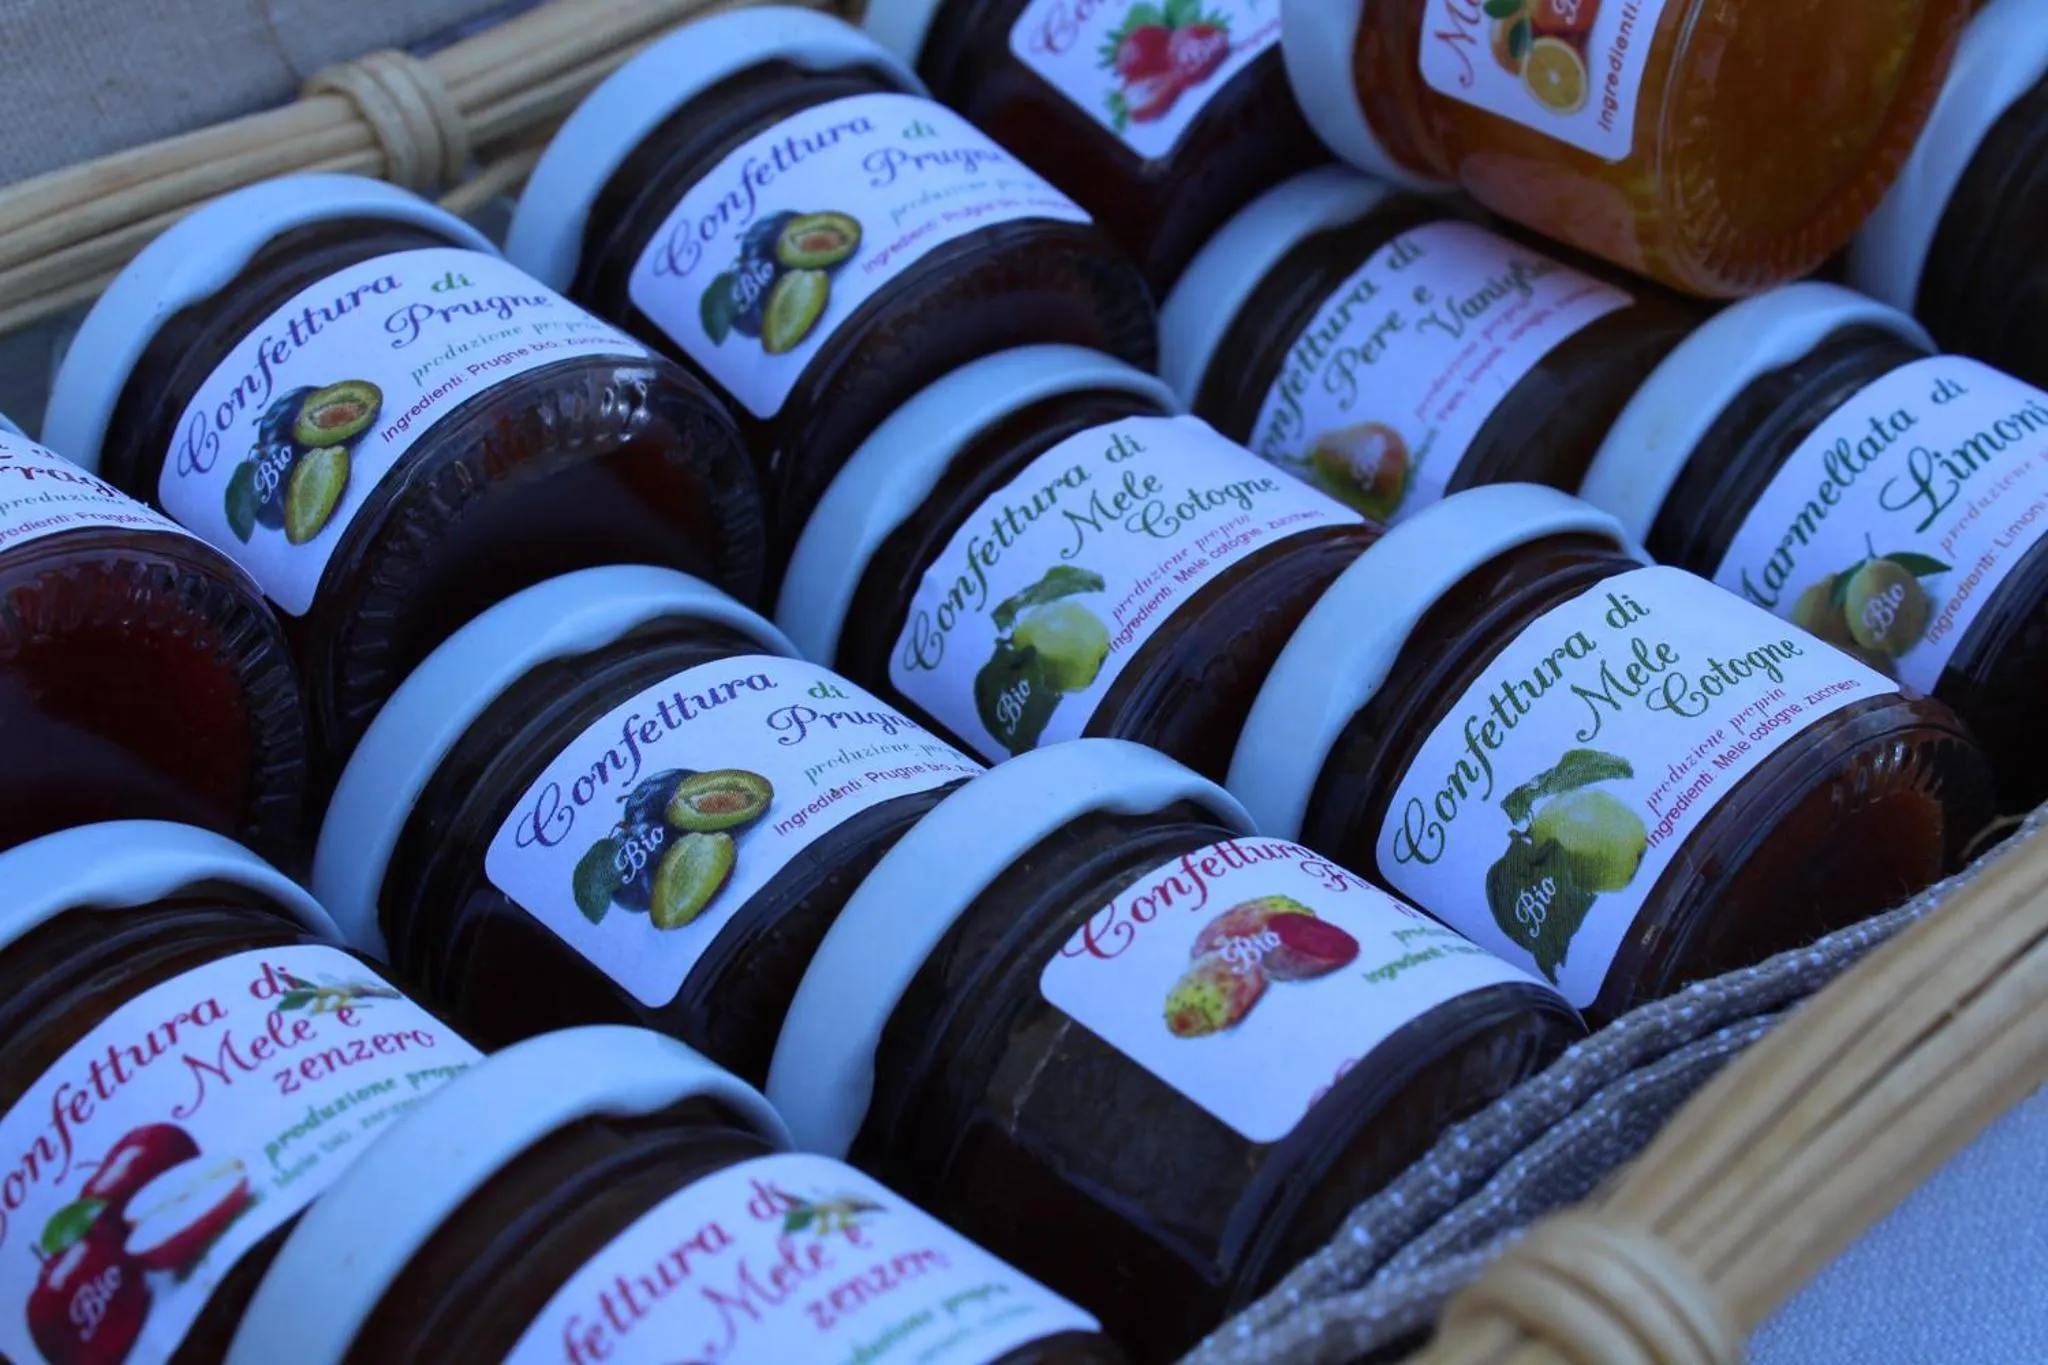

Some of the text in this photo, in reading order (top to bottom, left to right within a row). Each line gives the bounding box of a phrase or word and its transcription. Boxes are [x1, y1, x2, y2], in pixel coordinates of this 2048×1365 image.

[653, 116, 938, 278] Confettura di
[730, 258, 776, 313] Bio
[1385, 235, 1426, 272] di
[384, 294, 553, 350] Prugne
[1324, 310, 1406, 413] Pere
[1411, 284, 1434, 306] e
[177, 271, 476, 478] Confettura di
[409, 325, 524, 388] produzione
[380, 375, 468, 443] Ingredienti:
[466, 344, 531, 377] Prugne
[1930, 377, 1970, 405] di
[254, 445, 293, 504] Bio
[1060, 470, 1163, 560] Mele
[1125, 475, 1280, 540] Cotogne
[1993, 498, 2047, 550] Limoni
[903, 432, 1147, 672] Confettura di
[1173, 556, 1210, 585] Mele
[1112, 547, 1188, 627] produzione
[1862, 582, 1906, 642] Bio
[996, 677, 1032, 736] Bio
[1570, 637, 1680, 743] Mele
[1646, 638, 1803, 718] Cotogne
[515, 673, 850, 849] Confettura di
[1393, 631, 1598, 865] Confettura
[1605, 592, 1650, 629] di
[1646, 687, 1786, 818] produzione propria
[1712, 739, 1752, 772] Mele
[804, 743, 910, 787] produzione
[864, 763, 926, 784] Prugne
[614, 826, 665, 885] Bio
[1515, 876, 1556, 938] Bio
[1221, 931, 1281, 975] Bio
[171, 1005, 361, 1121] Mele e
[273, 1029, 436, 1096] zenzero
[0, 998, 229, 1248] onfettura
[701, 1236, 836, 1361] Mele
